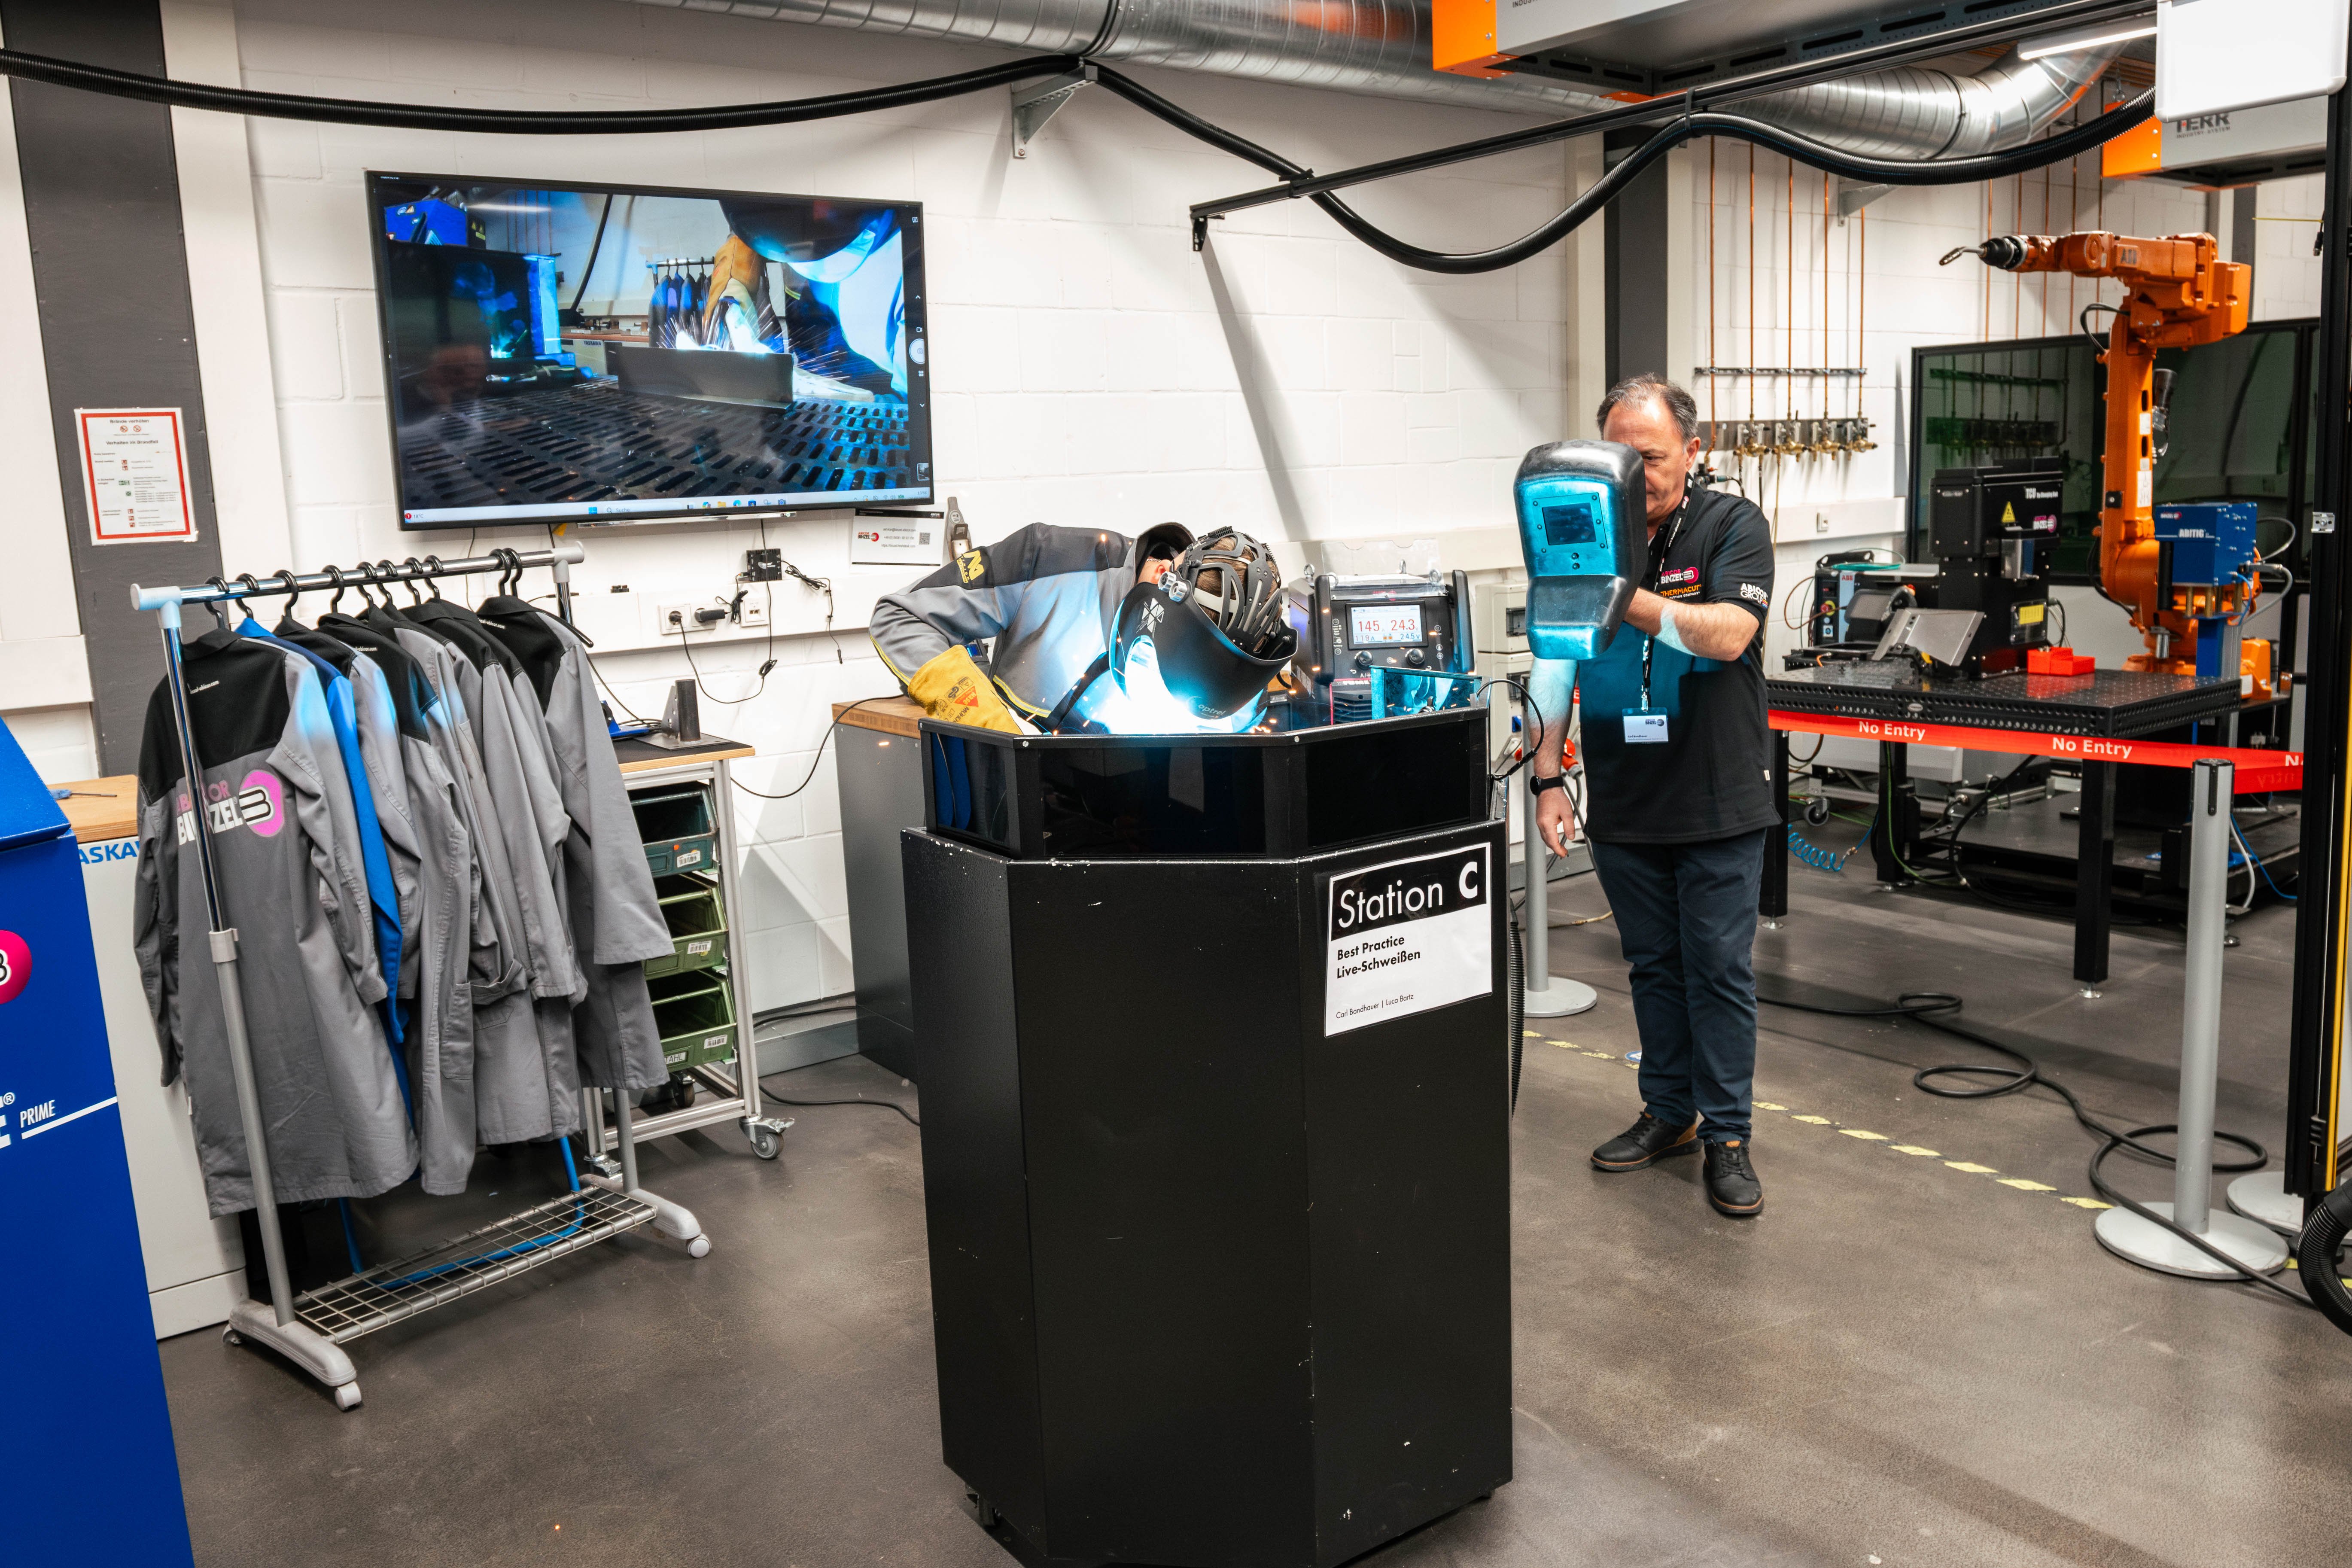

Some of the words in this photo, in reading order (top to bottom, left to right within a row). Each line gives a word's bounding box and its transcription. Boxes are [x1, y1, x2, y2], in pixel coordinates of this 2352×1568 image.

[1358, 620, 1380, 632] 145
[1391, 619, 1415, 631] 24.3
[1198, 704, 1226, 715] optrel
[1859, 721, 1879, 734] No
[1884, 723, 1926, 741] Entry
[2053, 737, 2077, 752] No
[2083, 740, 2133, 759] Entry
[1338, 880, 1443, 928] Station
[1459, 862, 1478, 899] C
[1337, 945, 1360, 960] Best
[1362, 936, 1405, 954] Practice
[1337, 950, 1421, 979] Live-Schweißen
[1336, 1009, 1348, 1019] Carl
[1350, 1003, 1379, 1016] Bandhauer
[1400, 994, 1414, 1002] Bartz
[20, 1099, 55, 1128] PRIME
